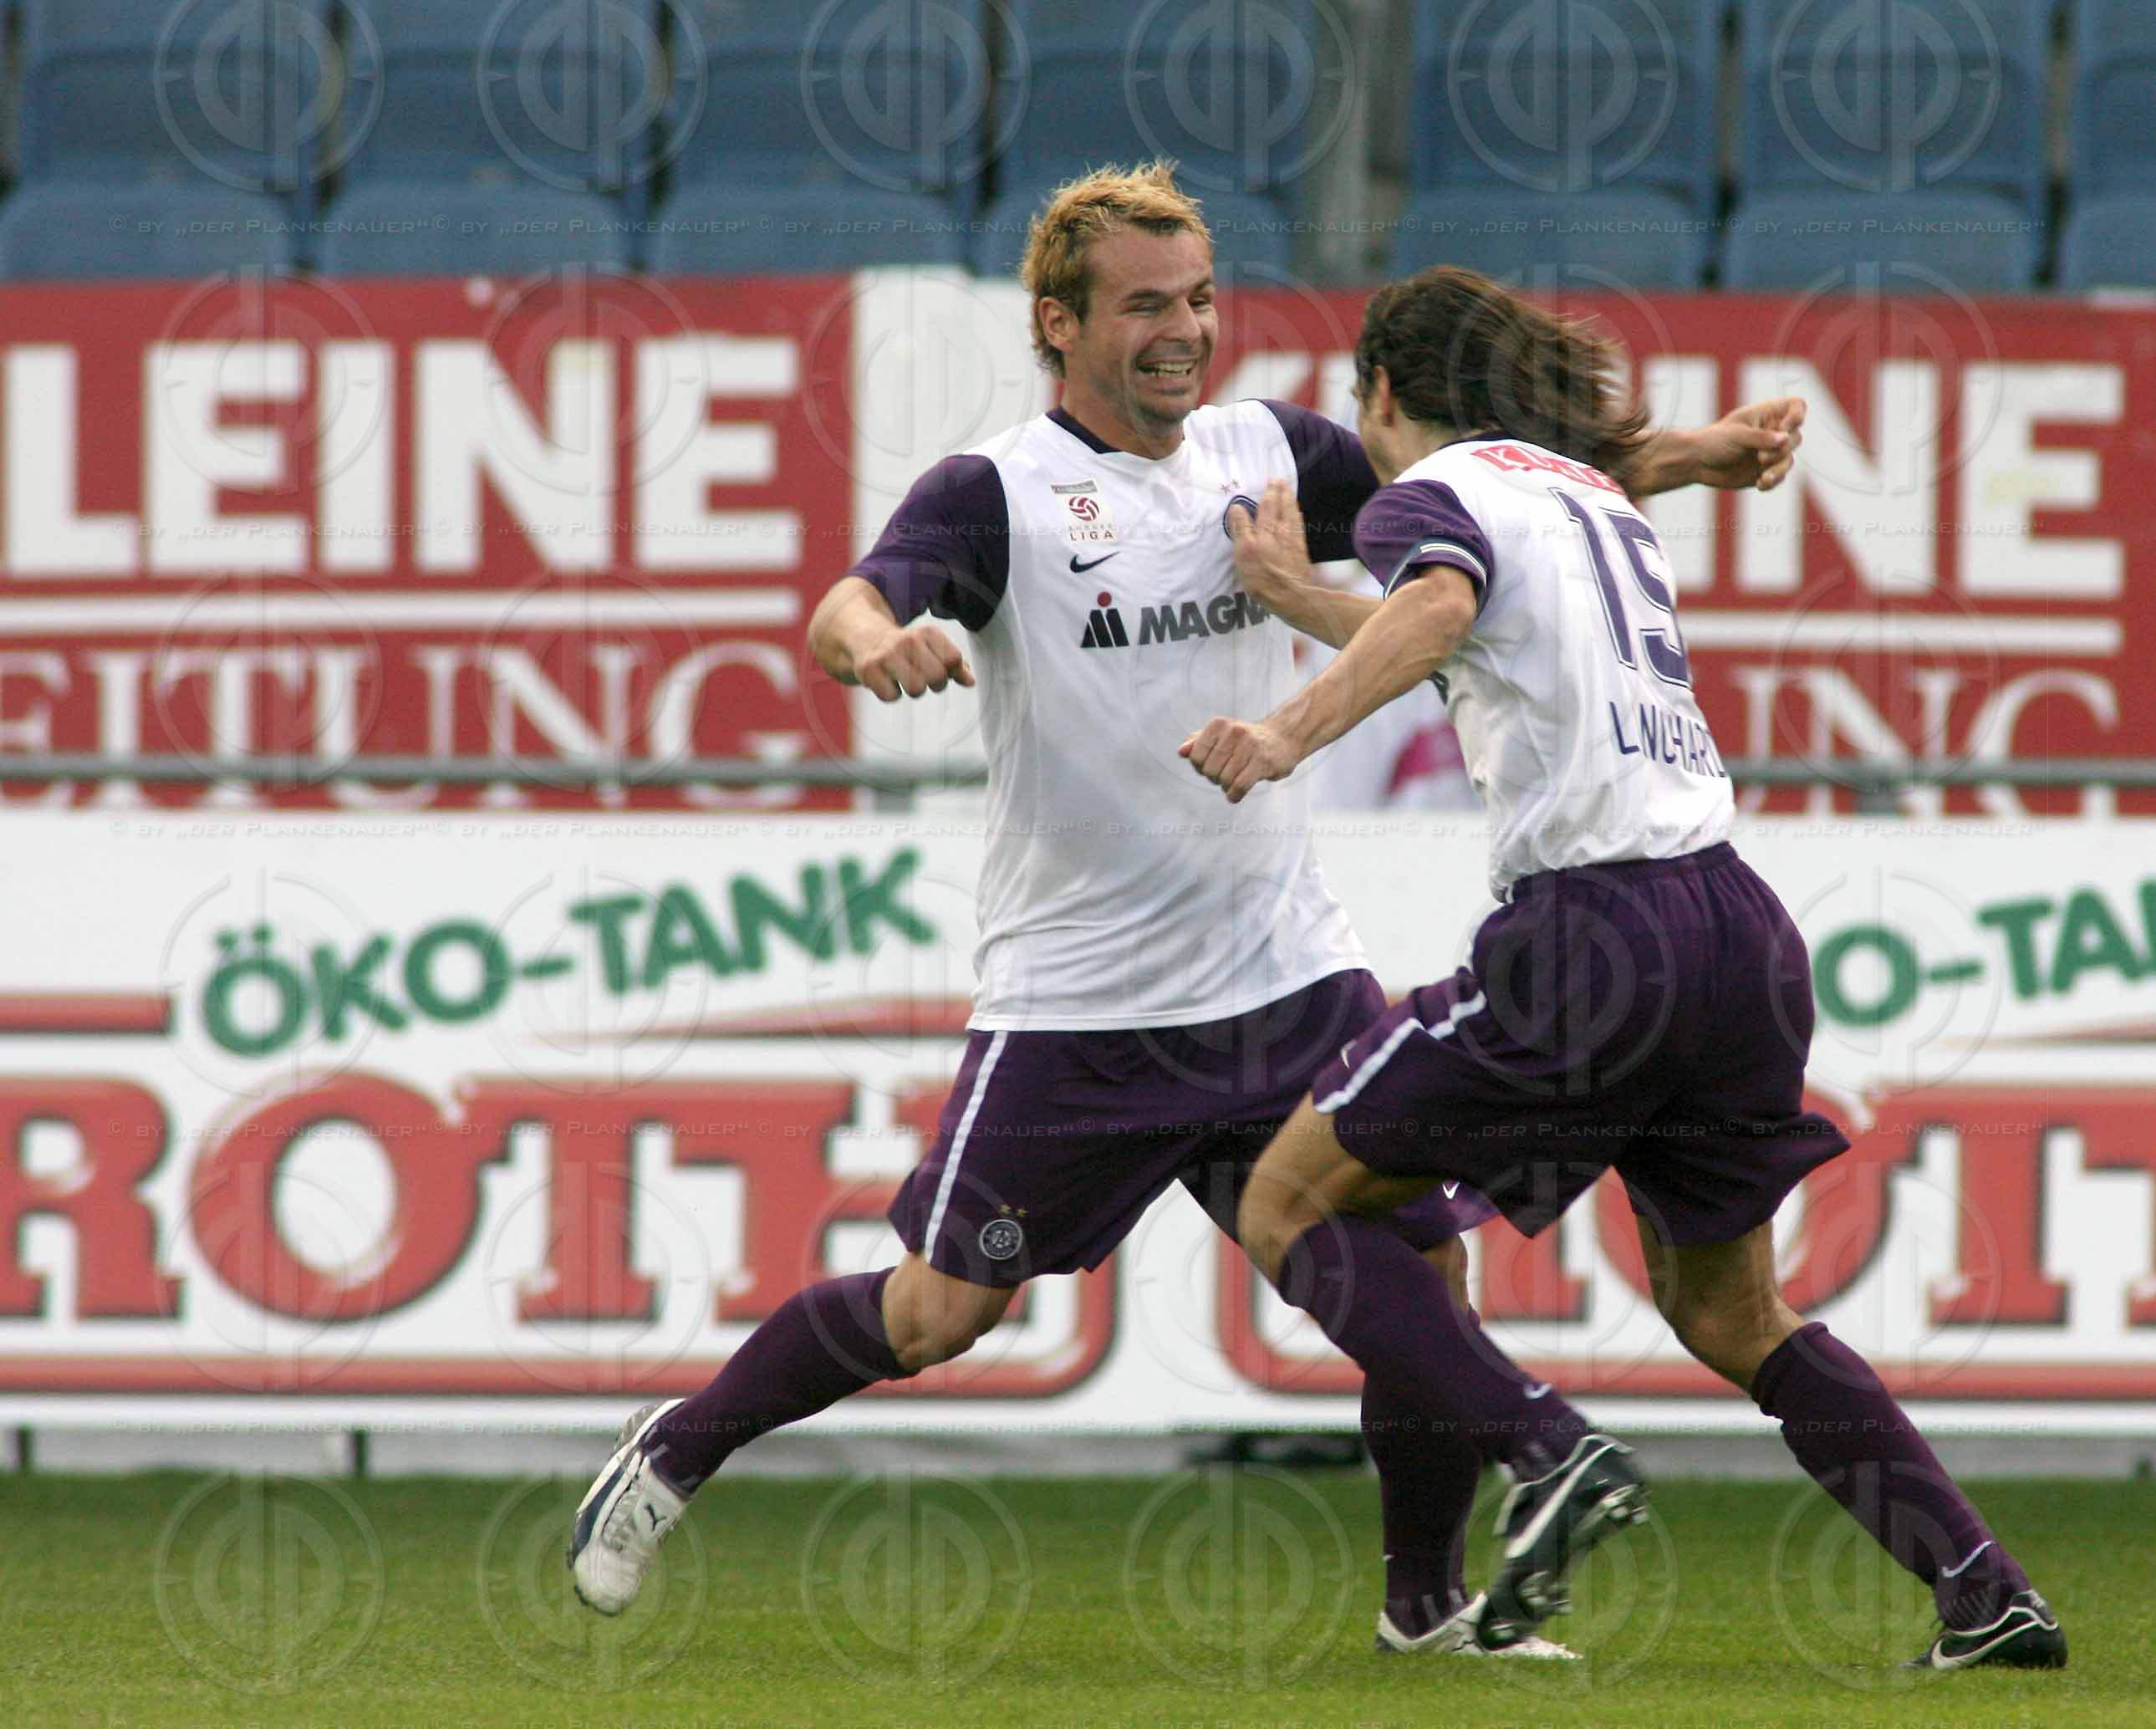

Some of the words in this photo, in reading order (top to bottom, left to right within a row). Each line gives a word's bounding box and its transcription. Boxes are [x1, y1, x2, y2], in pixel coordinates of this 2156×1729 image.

[1069, 529, 1114, 542] LIGA
[1548, 487, 1689, 689] 15
[1138, 591, 1271, 645] MAGN
[201, 846, 938, 1058] ÖKO-TANK
[1812, 876, 2156, 1028] O-TA
